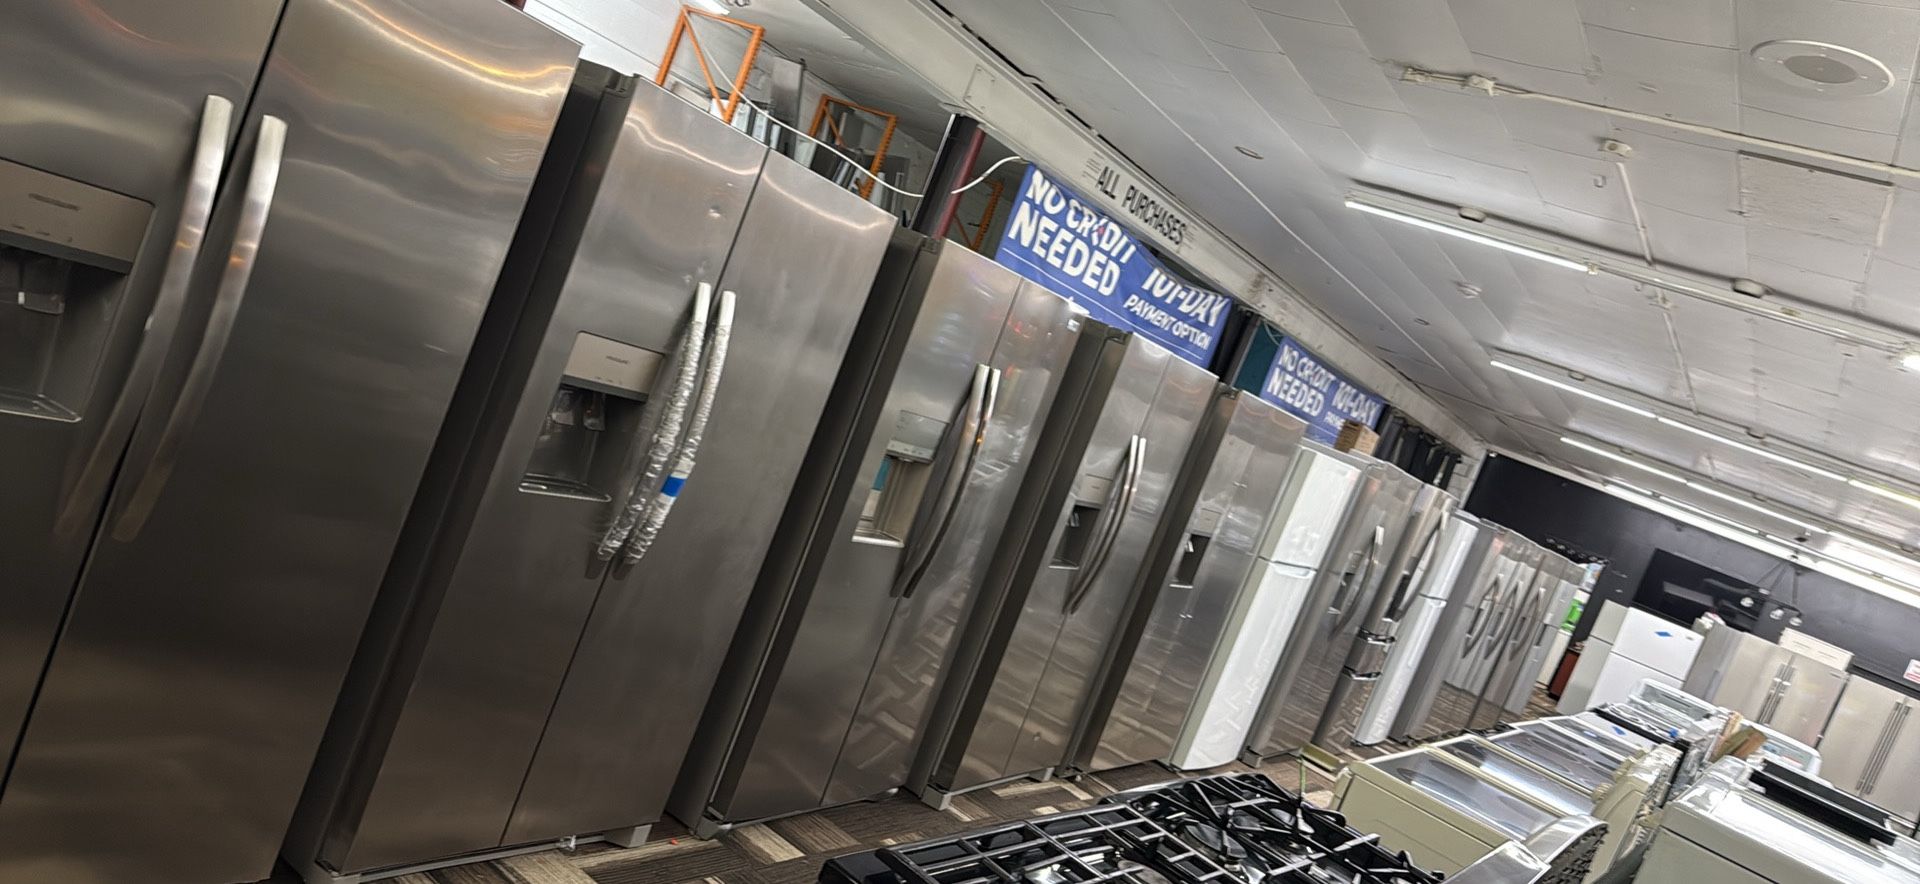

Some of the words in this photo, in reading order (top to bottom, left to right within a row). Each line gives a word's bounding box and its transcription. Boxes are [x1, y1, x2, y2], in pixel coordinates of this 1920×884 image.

[1025, 169, 1066, 215] NO
[1095, 166, 1120, 199] ALL
[1121, 185, 1187, 245] PURCHASES
[1007, 200, 1120, 296] NEEDED
[1123, 294, 1178, 331] PAYMENT
[1172, 321, 1213, 350] OPTION
[1141, 267, 1230, 327] 101-DAY
[1278, 344, 1300, 372] NO
[1266, 367, 1325, 417] NEEDED
[1331, 381, 1380, 426] 101-DAY
